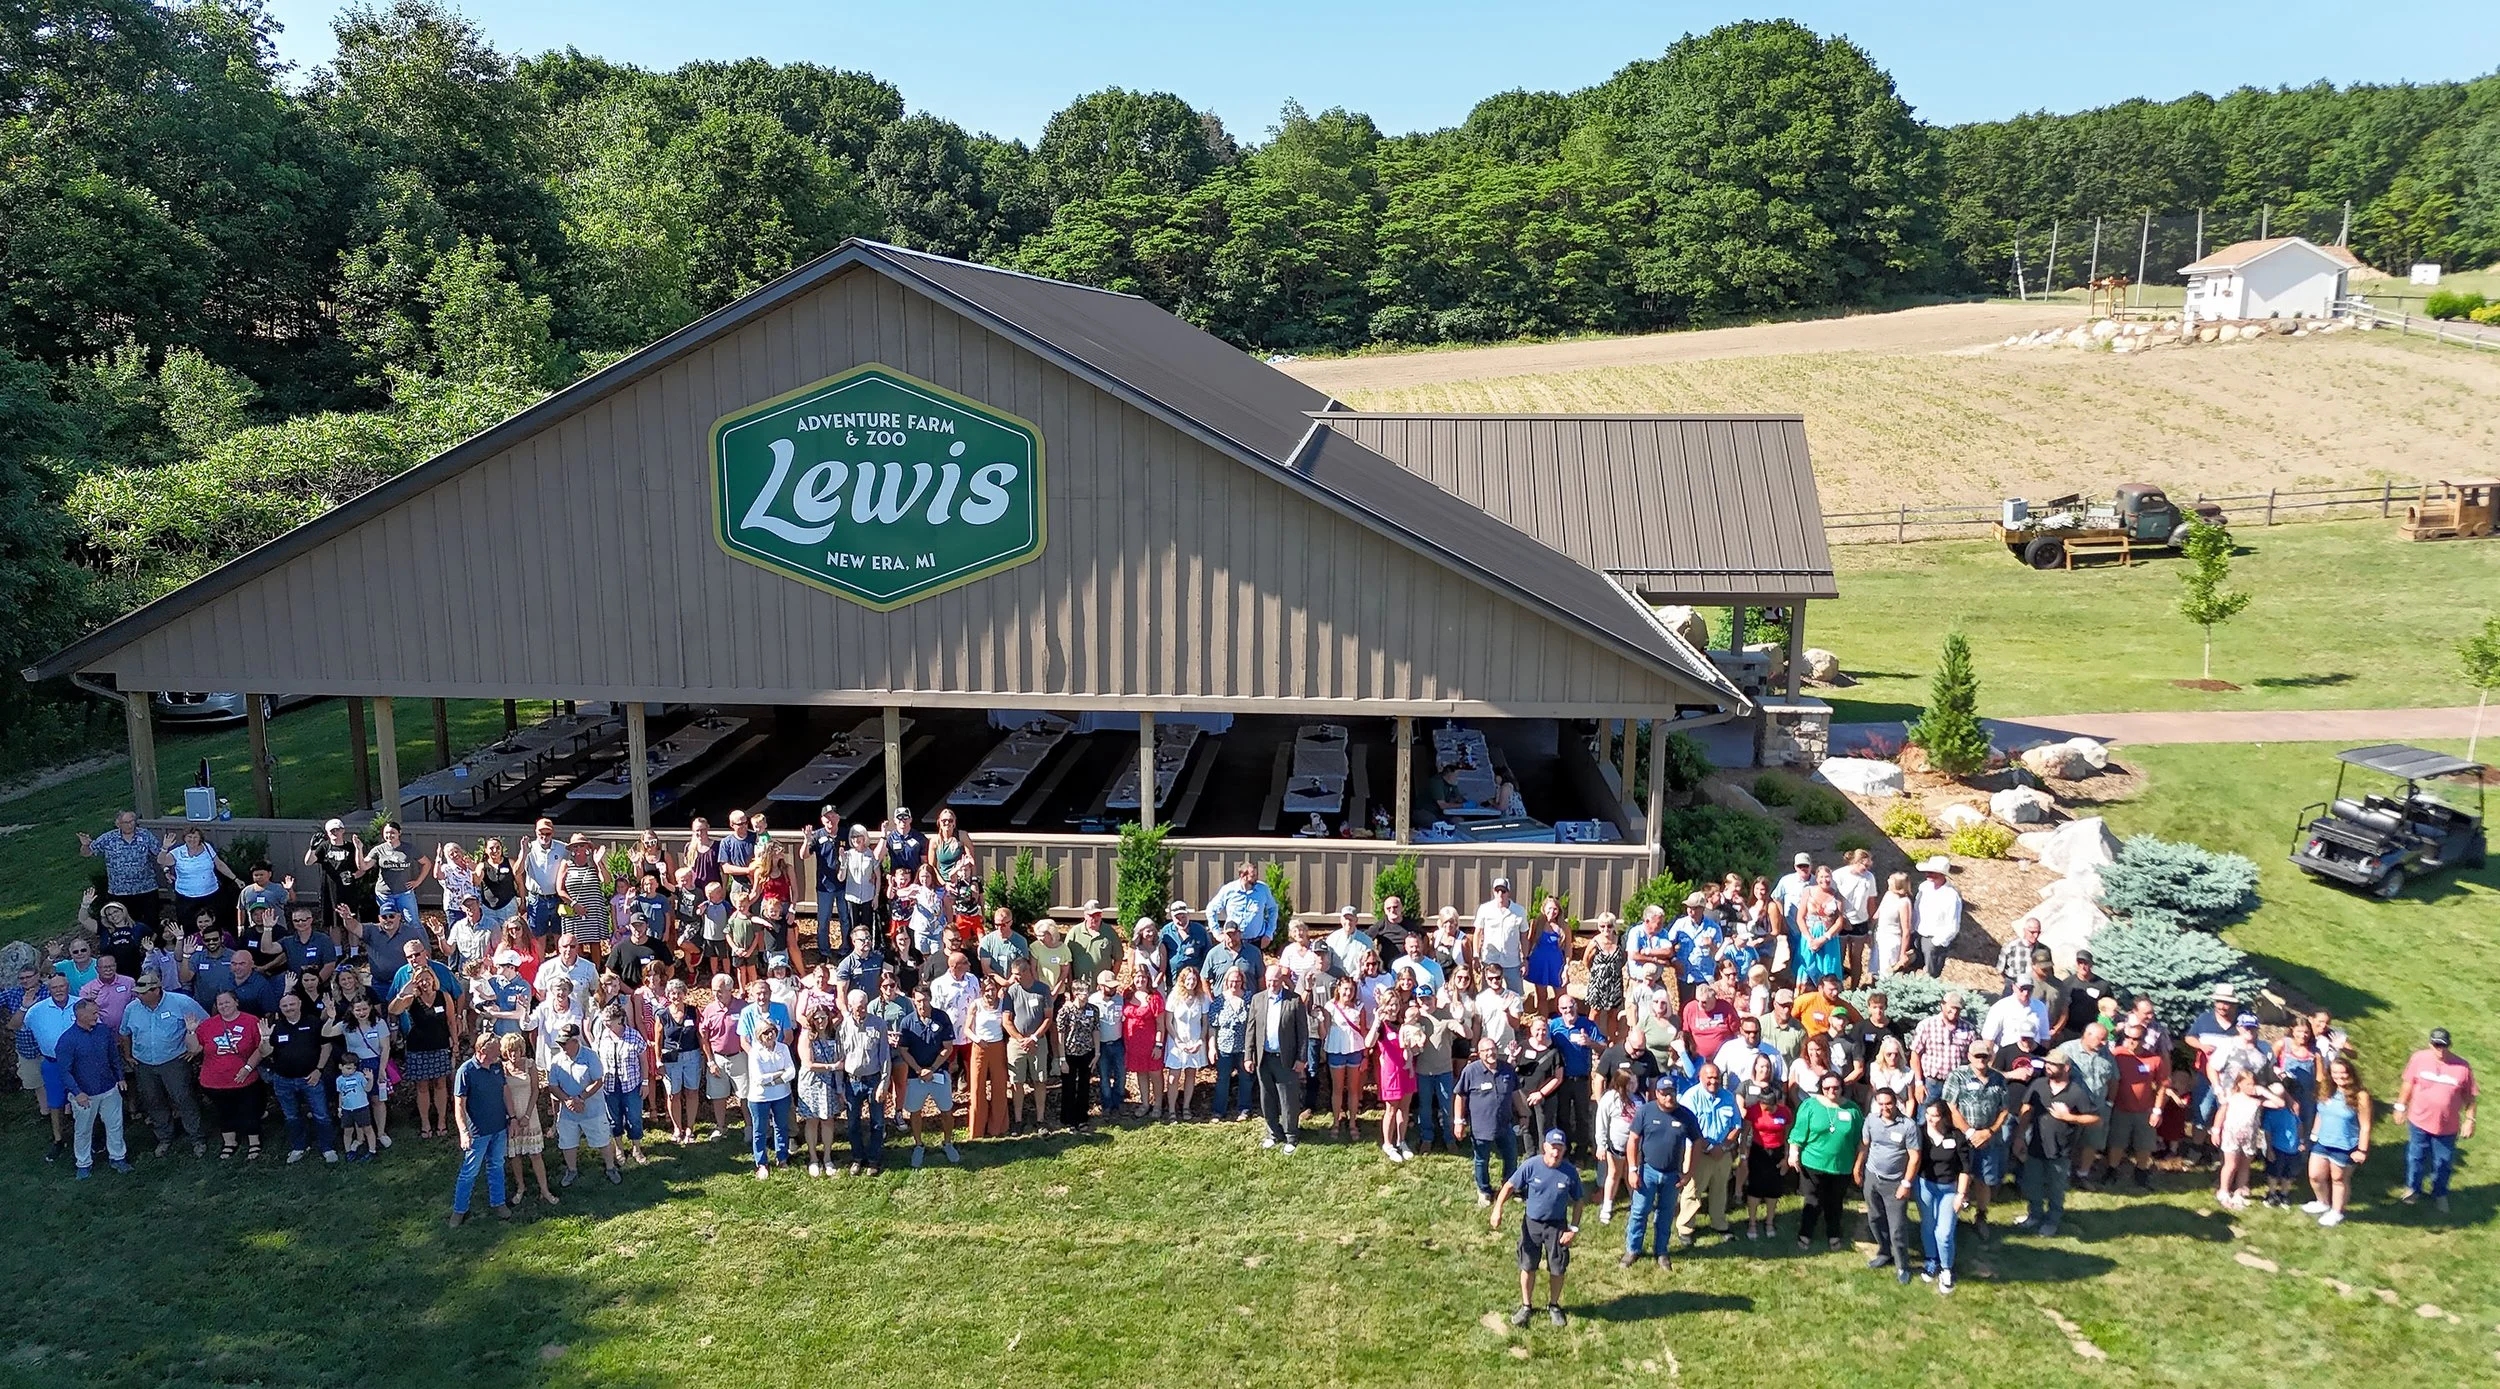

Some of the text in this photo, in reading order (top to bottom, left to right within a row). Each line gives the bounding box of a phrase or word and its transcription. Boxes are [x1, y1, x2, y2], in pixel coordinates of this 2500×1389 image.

[797, 412, 955, 435] ADVENTURE FARM
[845, 430, 907, 446] & ZOO
[740, 438, 1018, 544] Lewis
[826, 551, 936, 571] NEW ERA, MI
